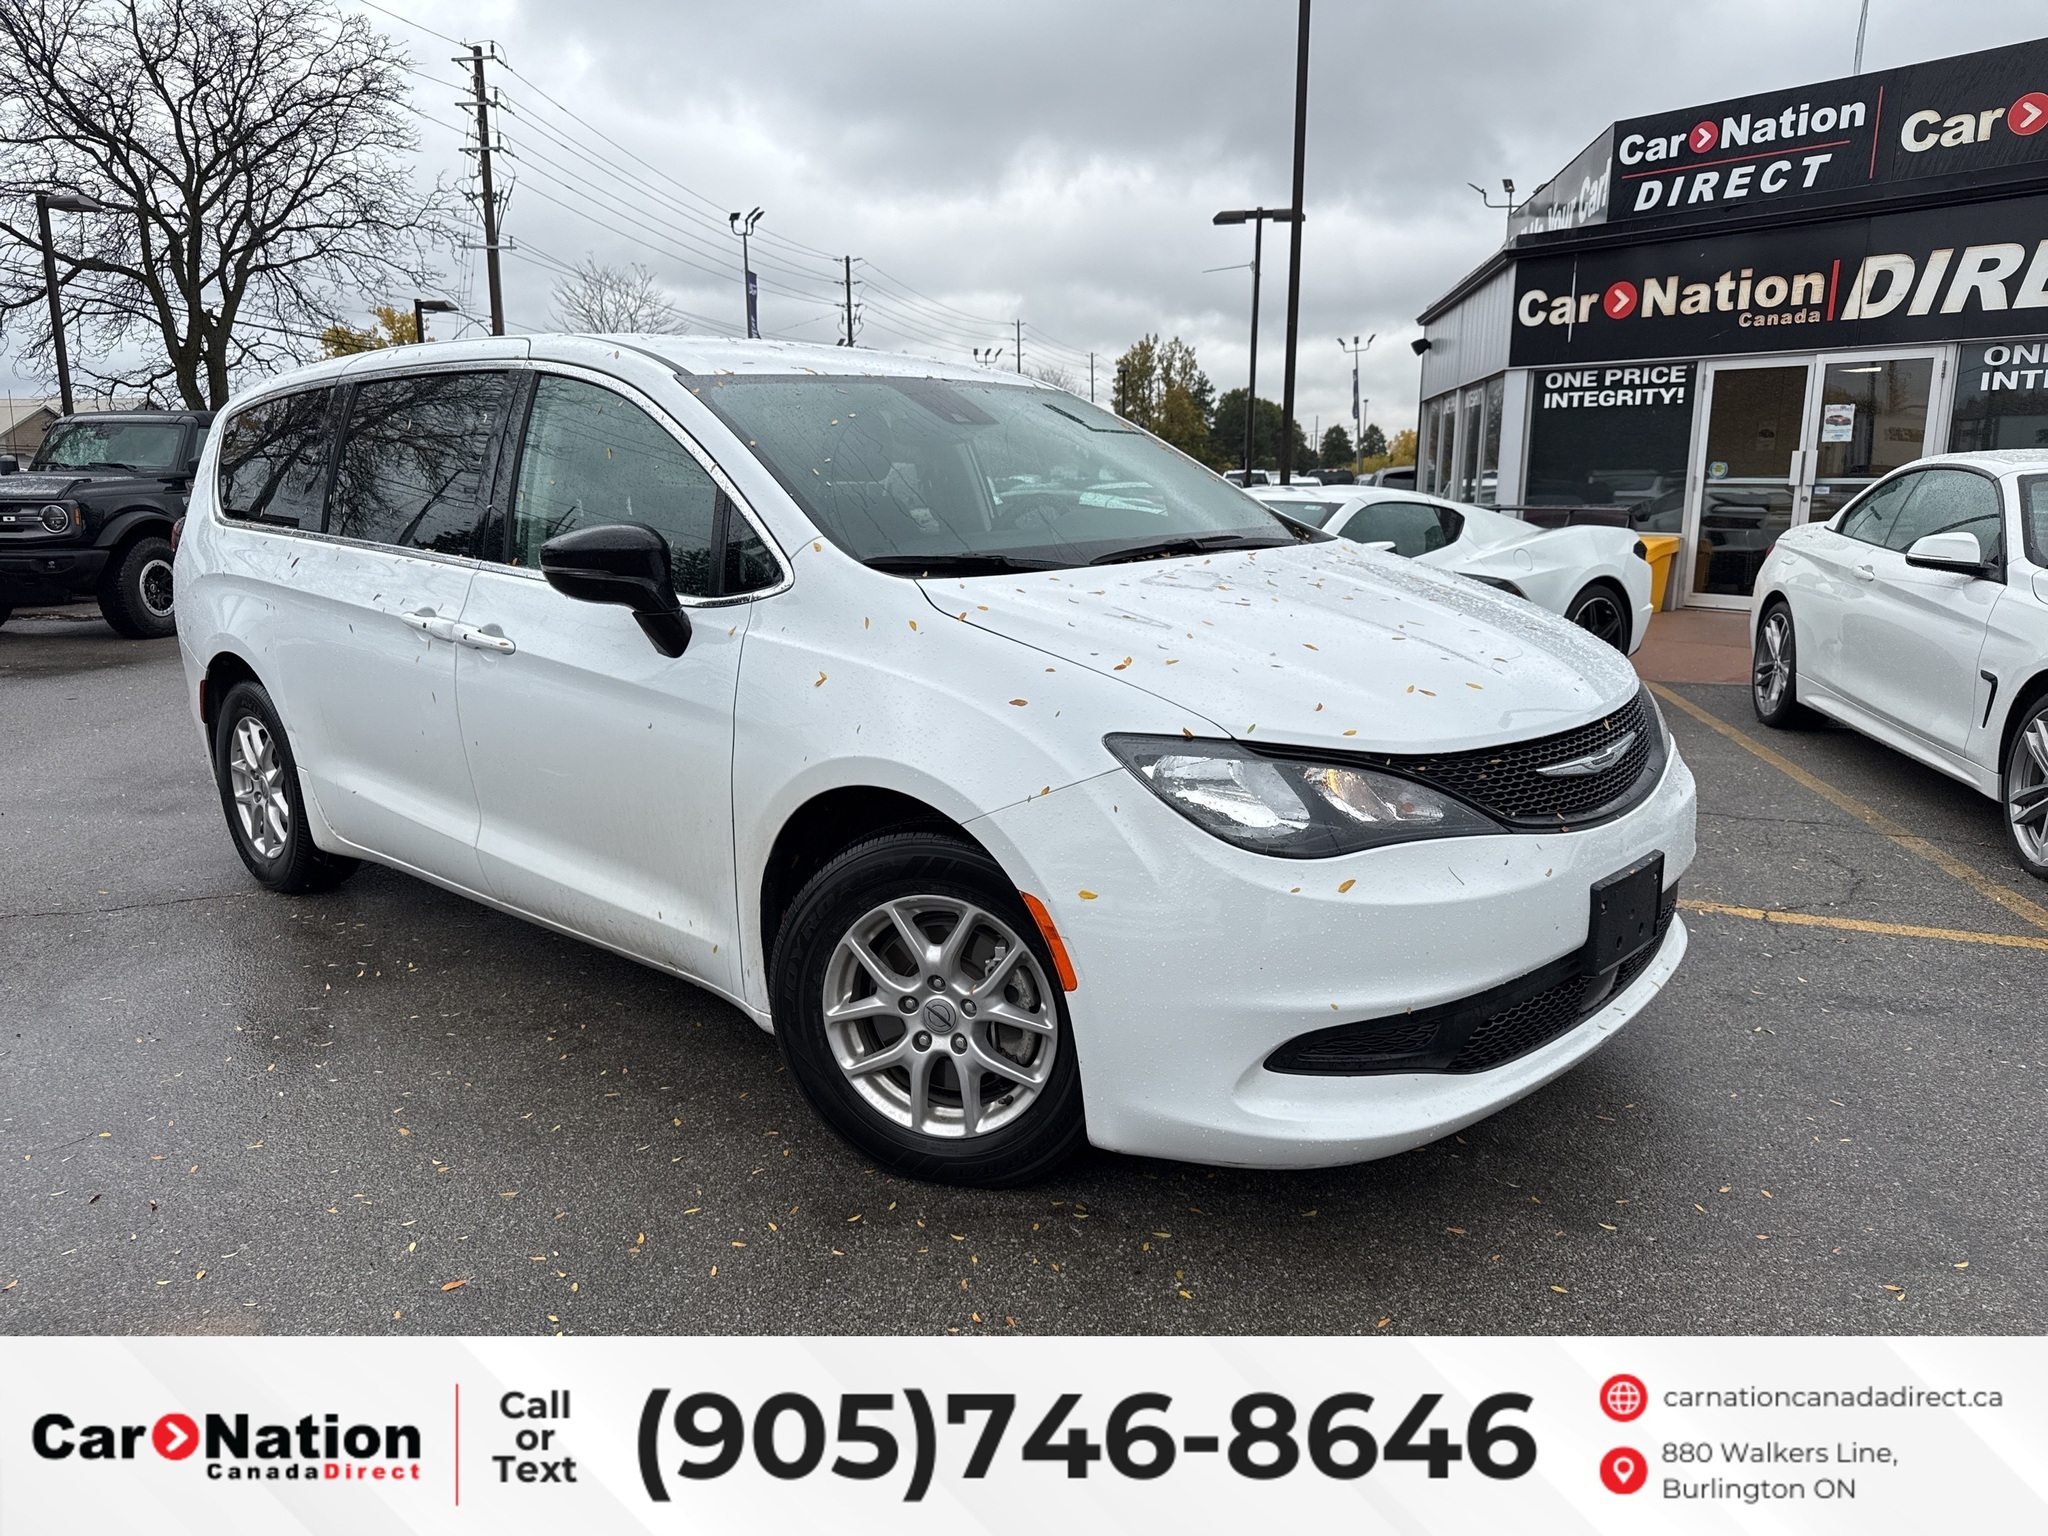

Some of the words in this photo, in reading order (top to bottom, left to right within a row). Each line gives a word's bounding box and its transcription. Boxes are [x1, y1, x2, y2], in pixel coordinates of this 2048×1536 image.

[1619, 134, 1687, 166] Car
[1720, 101, 1867, 149] Nation
[1900, 106, 2007, 153] Car
[1633, 153, 1833, 212] DIRECT
[1518, 289, 1600, 327] Car
[1640, 268, 1827, 318] Nation
[1738, 308, 1821, 328] Canada
[1983, 343, 2048, 366] ON
[1545, 369, 1599, 389] ONE
[1604, 365, 1688, 387] PRICE
[1980, 369, 2048, 391] INT
[1543, 387, 1685, 409] INTEGRITY!
